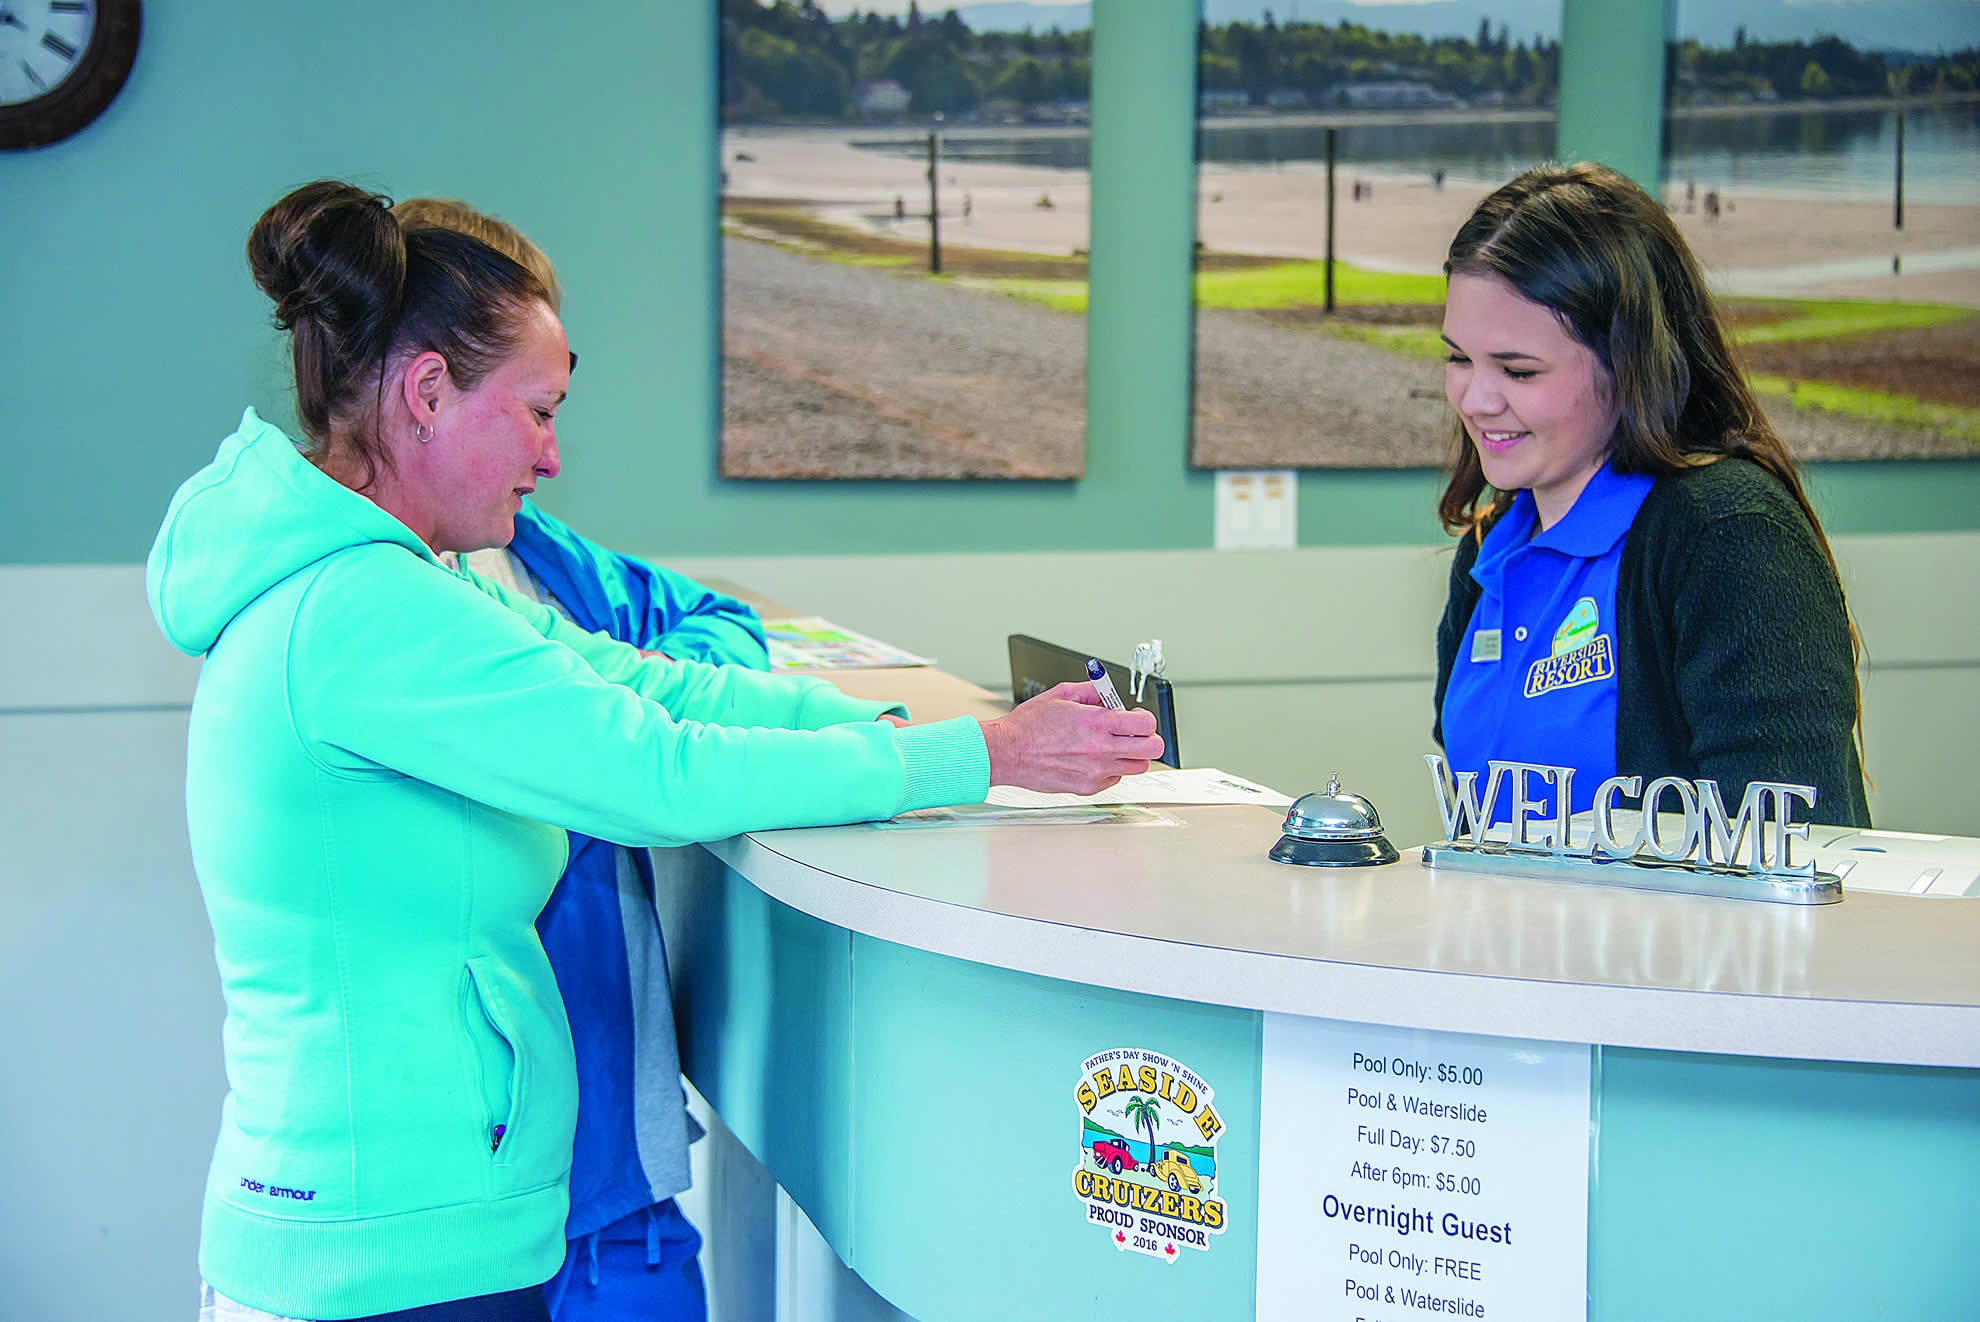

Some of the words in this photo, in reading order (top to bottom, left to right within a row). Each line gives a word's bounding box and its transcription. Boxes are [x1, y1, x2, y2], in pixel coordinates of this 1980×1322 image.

[1529, 653, 1608, 693] RESORT
[1534, 639, 1606, 675] RIVERSIDE
[1423, 754, 1816, 878] WELCOME
[1085, 1051, 1121, 1070] FATHER'S
[1123, 1050, 1140, 1060] DAY
[1142, 1053, 1169, 1067] SHOW
[1182, 1069, 1208, 1095] SHINE
[1353, 1052, 1386, 1074] Pool
[1391, 1058, 1432, 1083] Only:
[1437, 1063, 1483, 1086] $5.00
[1077, 1064, 1222, 1141] SEASIDE
[1348, 1087, 1381, 1109] Pool
[1386, 1093, 1397, 1111] &
[1402, 1095, 1487, 1122] Waterslide
[1358, 1125, 1384, 1145] Full
[1390, 1129, 1425, 1154] Day:
[1430, 1134, 1476, 1158] $7.50
[269, 1185, 317, 1201] armour
[1351, 1160, 1387, 1182] After
[1392, 1166, 1430, 1189] 6pm:
[1435, 1171, 1481, 1195] $5.00
[1075, 1170, 1223, 1229] CRUIZERS
[1089, 1204, 1134, 1228] PROUD
[1140, 1217, 1206, 1246] SPONSOR
[1323, 1194, 1434, 1236] Overnight
[1442, 1212, 1512, 1245] Guest
[1133, 1235, 1158, 1251] 2016
[1349, 1243, 1382, 1265] Pool
[1388, 1250, 1428, 1276] Only:
[1434, 1257, 1481, 1280] FREE
[1345, 1279, 1379, 1301] Pool
[1384, 1285, 1396, 1304] &
[1400, 1287, 1485, 1318] Waterslide
